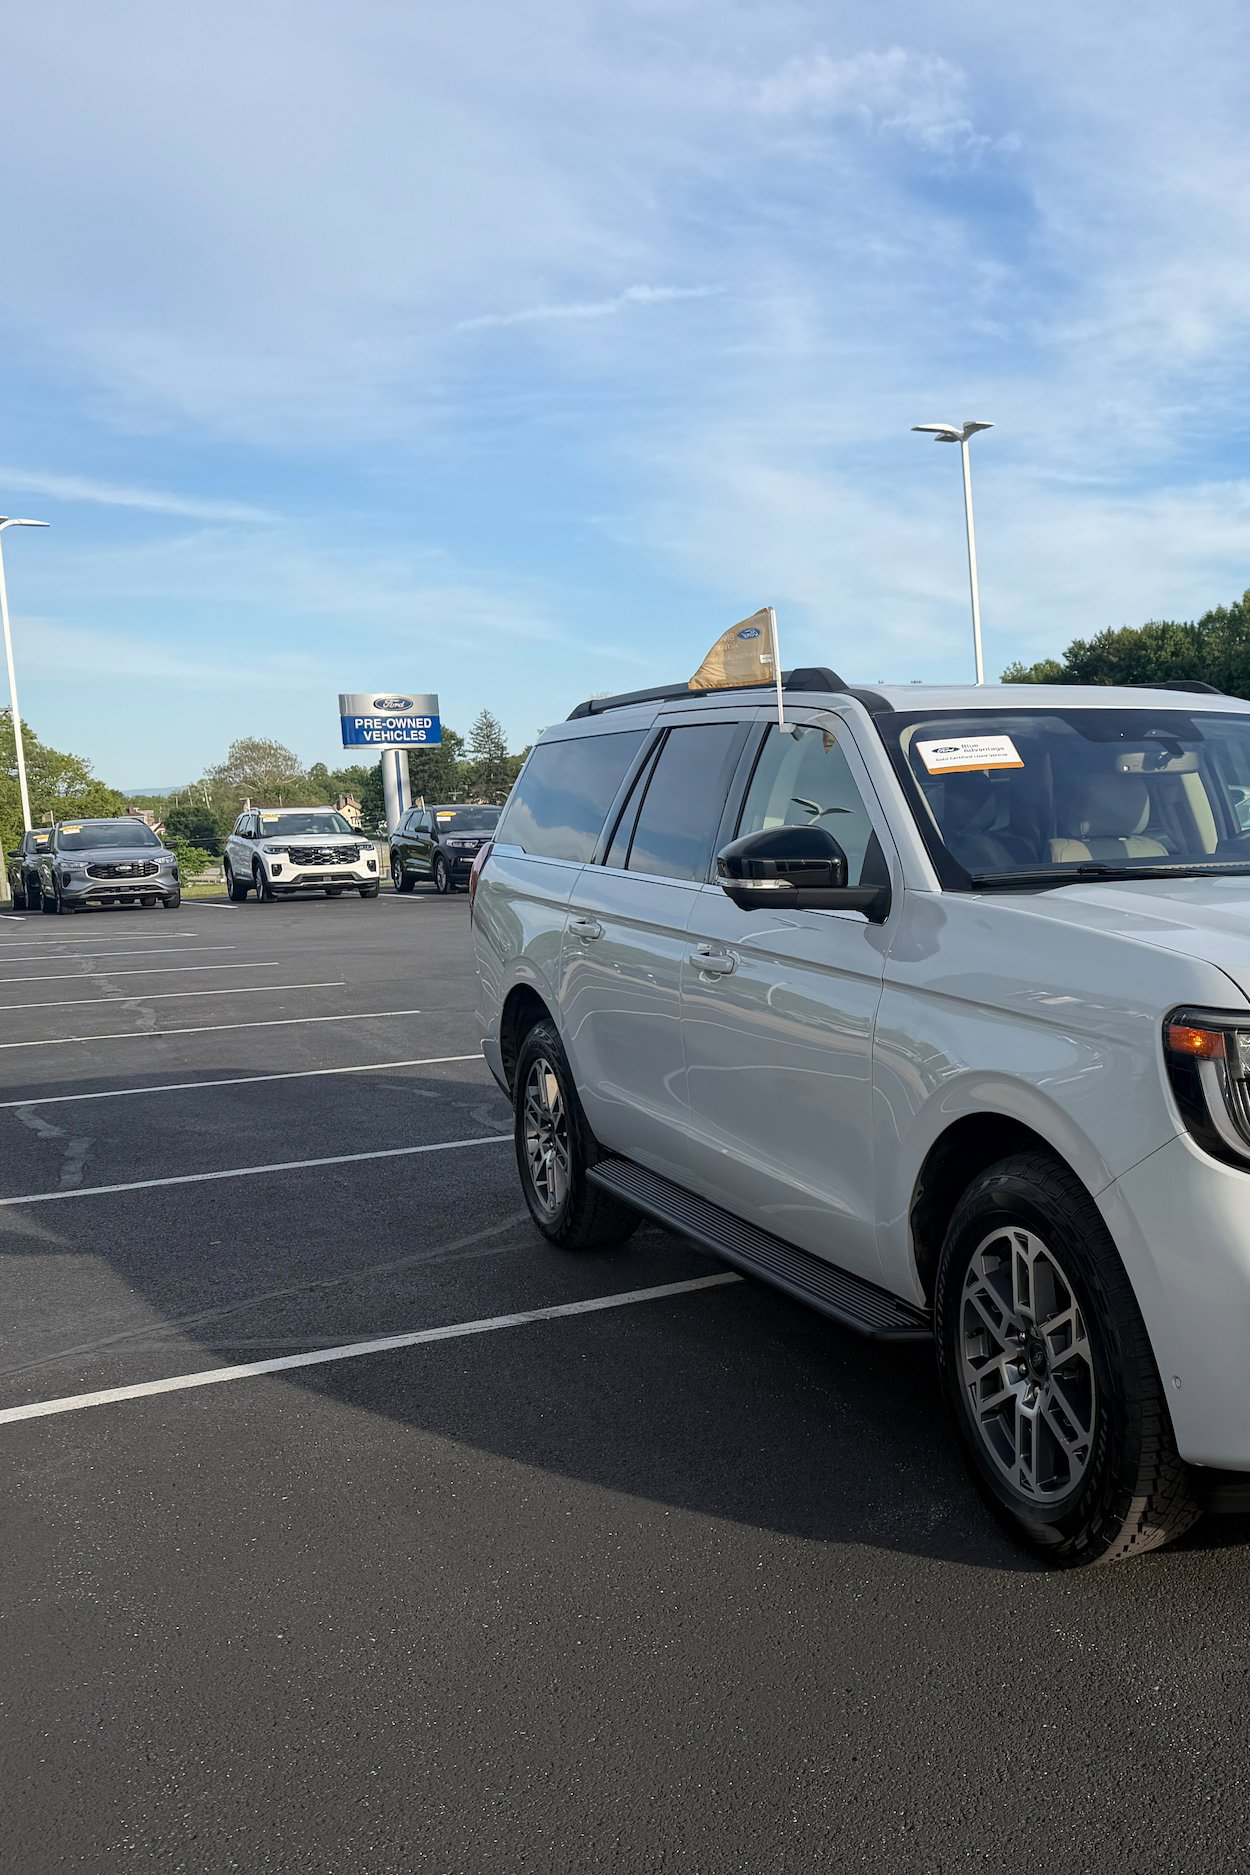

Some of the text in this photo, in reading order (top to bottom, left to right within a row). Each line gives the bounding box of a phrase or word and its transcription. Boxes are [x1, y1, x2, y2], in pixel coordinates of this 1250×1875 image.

[382, 699, 405, 709] Ford
[354, 718, 432, 729] PRE-OWNED
[363, 730, 426, 741] VEHICLES
